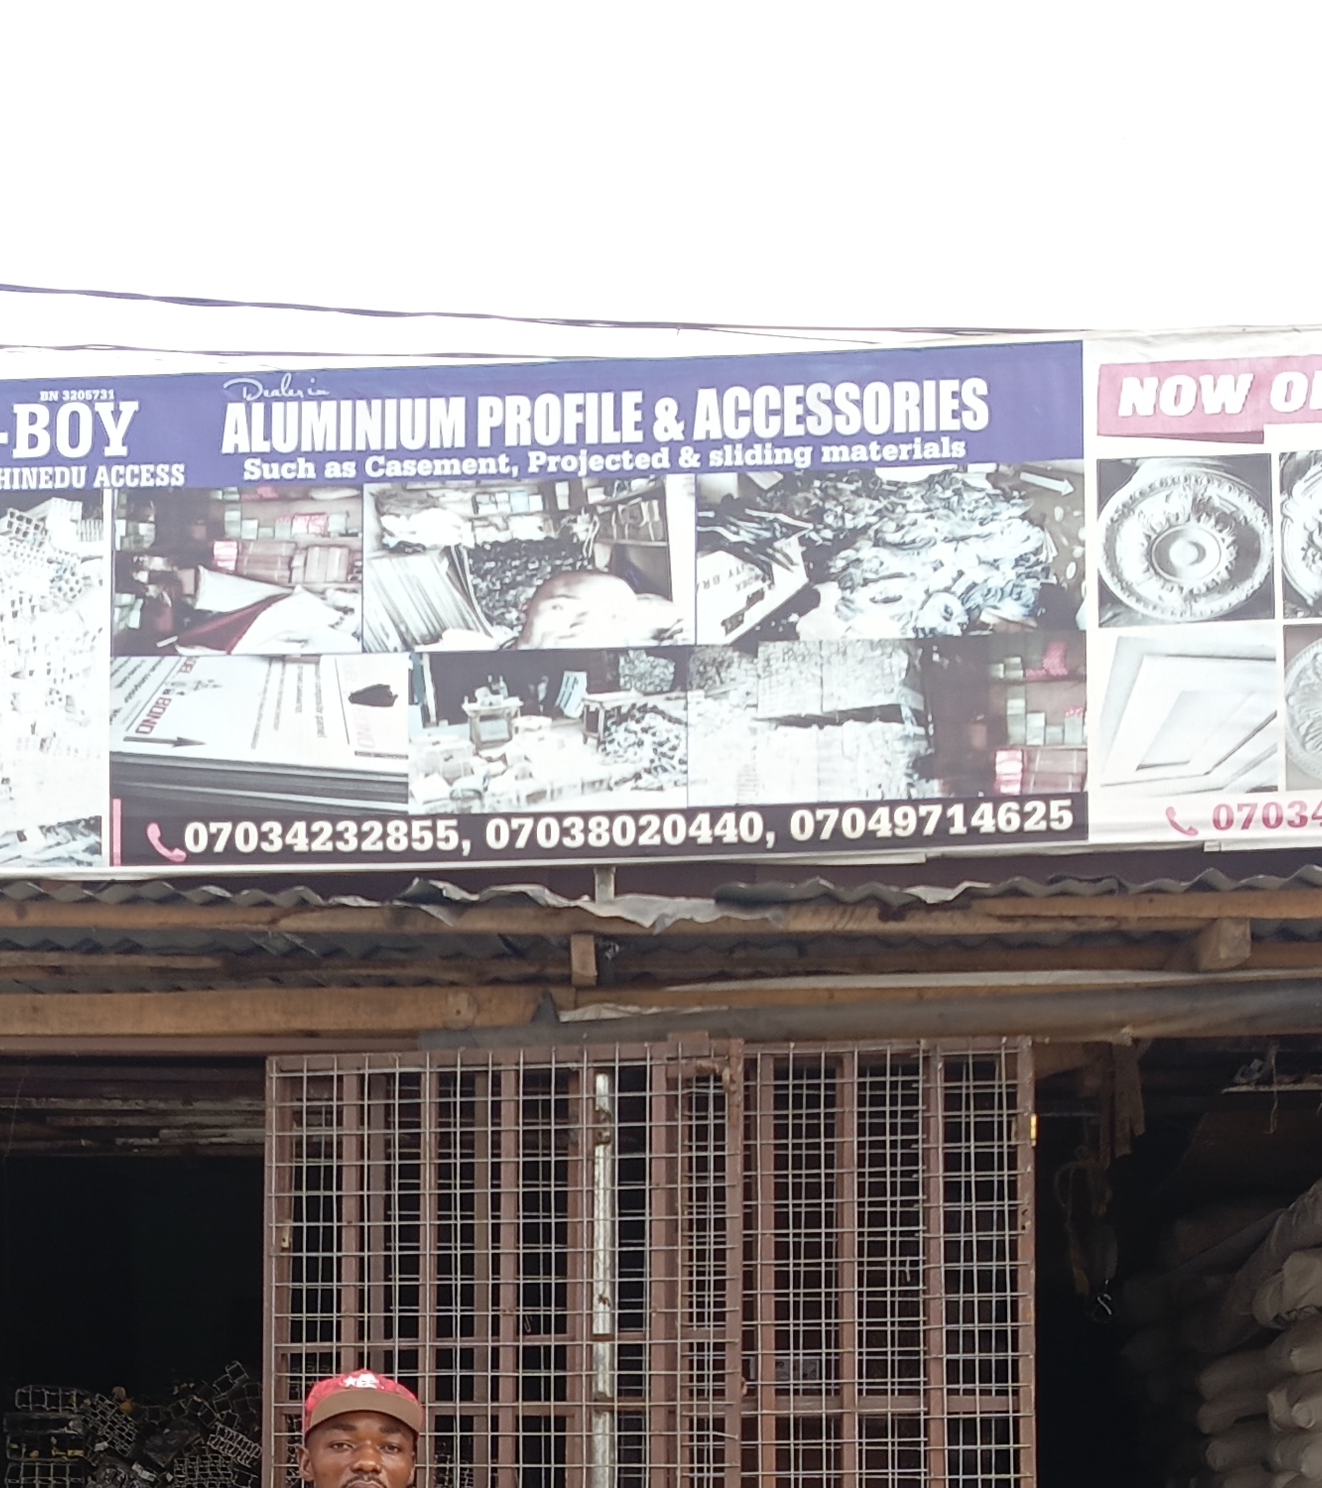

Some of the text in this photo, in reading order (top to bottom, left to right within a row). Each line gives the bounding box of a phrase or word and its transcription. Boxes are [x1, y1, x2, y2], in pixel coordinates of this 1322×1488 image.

[40, 391, 59, 401] BN
[221, 377, 990, 455] ALUMINIUM PROFILE & ACCESSORIES
[1118, 372, 1253, 418] NOW
[93, 462, 186, 489] ACCESS
[243, 437, 966, 481] Such as Casement, Projected & sliding materials
[183, 799, 1073, 857] 07034232855, 07038020440, 07049714625
